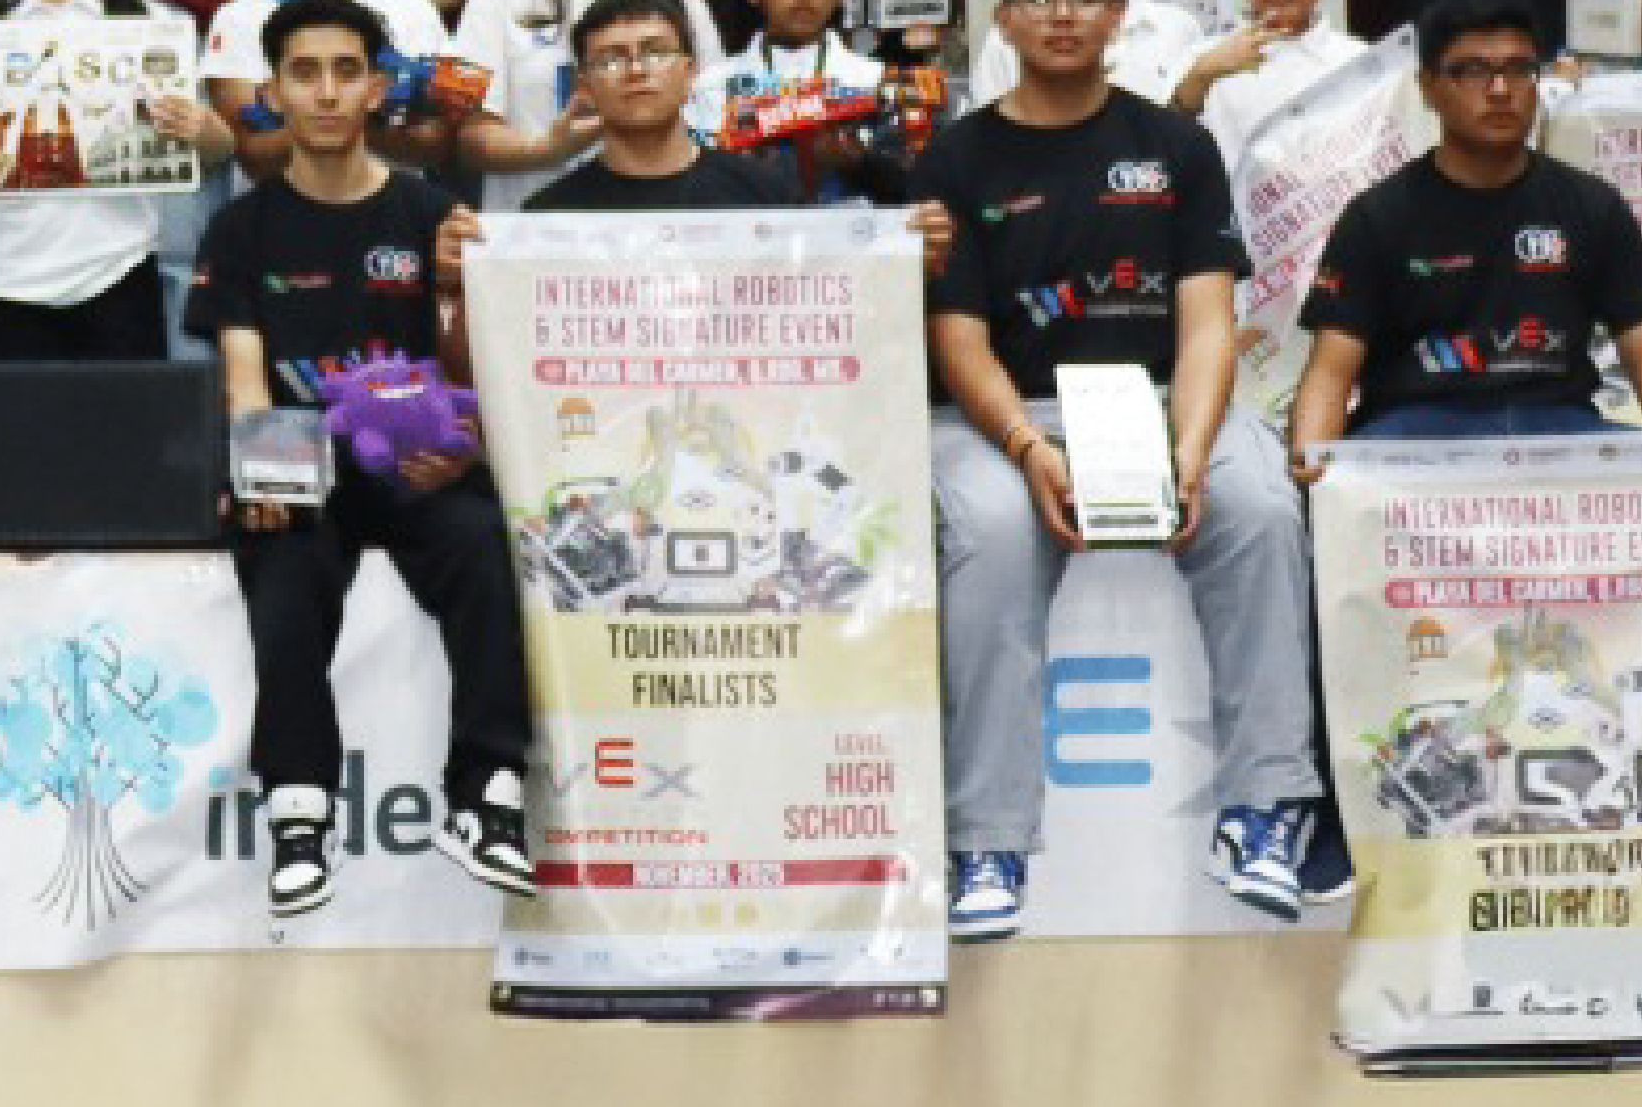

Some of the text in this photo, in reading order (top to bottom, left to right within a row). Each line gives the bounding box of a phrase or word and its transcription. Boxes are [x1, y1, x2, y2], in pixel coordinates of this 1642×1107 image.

[733, 275, 853, 307] ROBOTICS
[561, 316, 627, 345] STEM
[779, 312, 856, 344] EVENT
[1384, 495, 1568, 529] INTERNATIONAL
[1410, 534, 1474, 568] STEM
[1486, 532, 1616, 567] SIGNATURE
[606, 624, 801, 661] TOURNAMENT
[632, 672, 778, 709] FINALISTS
[546, 738, 702, 800] VEX
[824, 761, 896, 794] HIGH
[783, 803, 897, 841] SCHOOL
